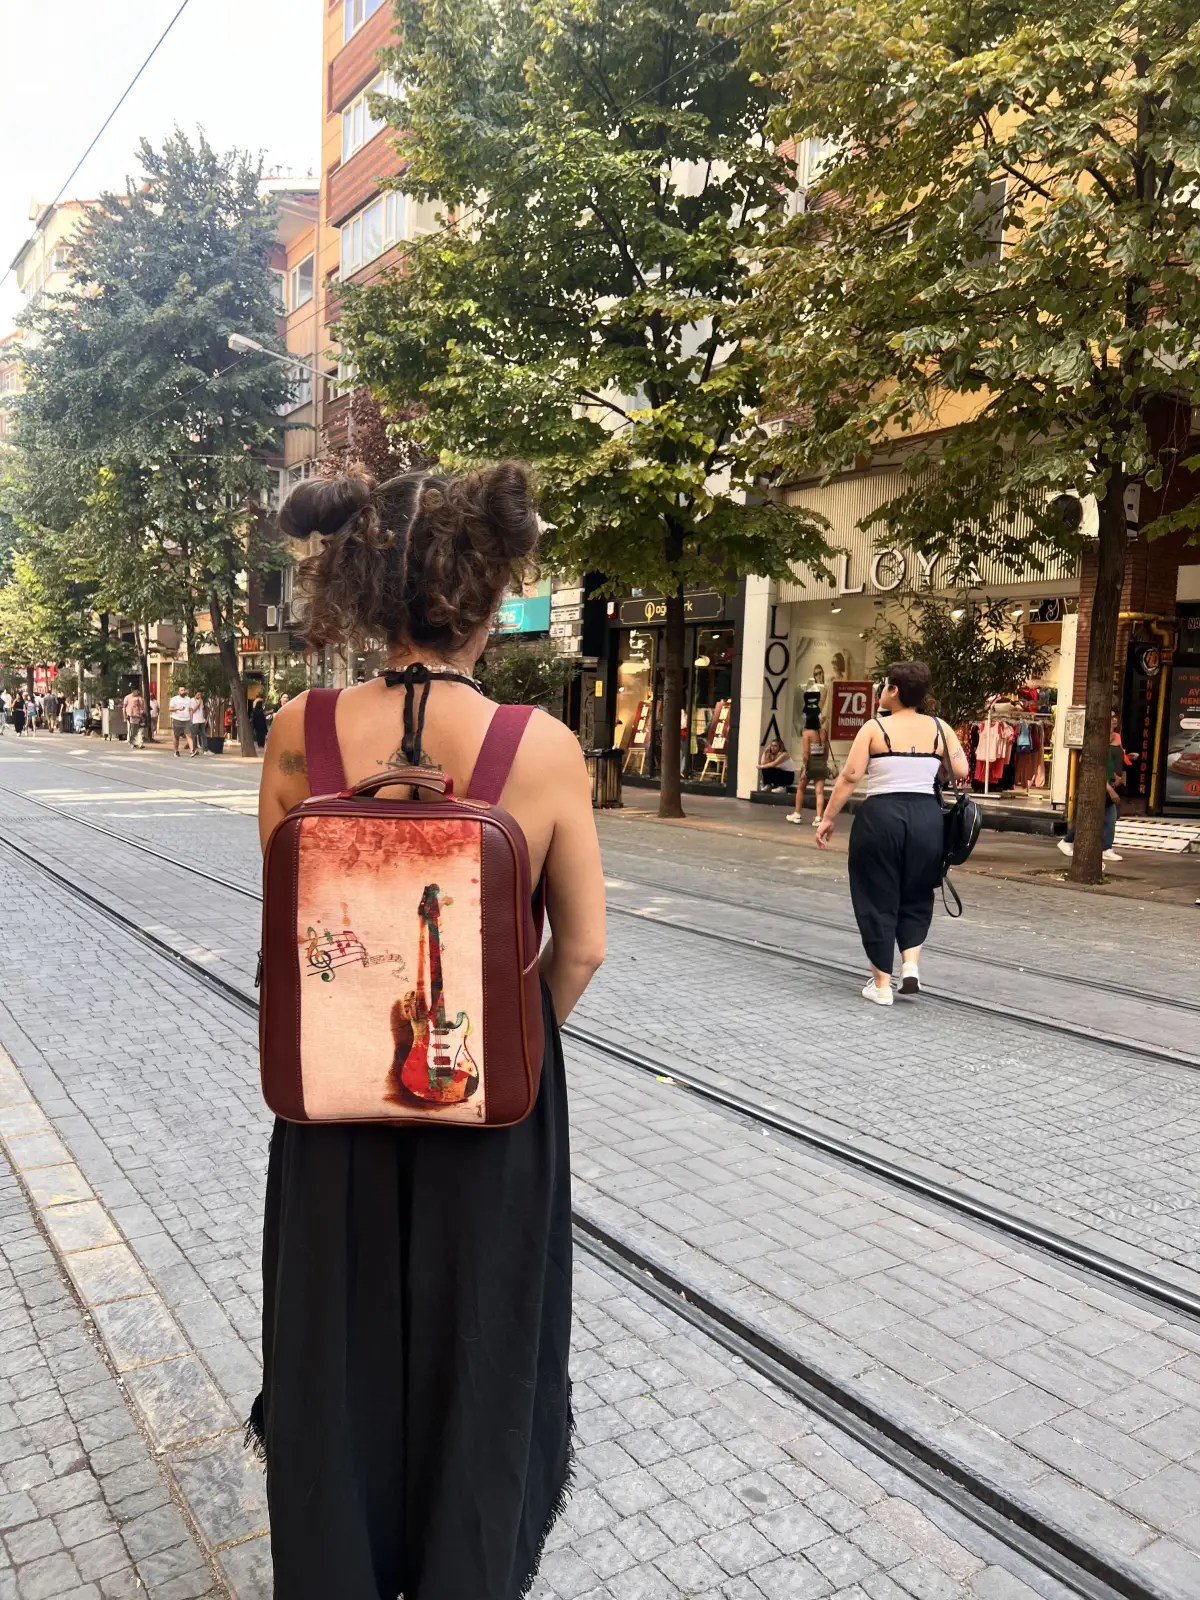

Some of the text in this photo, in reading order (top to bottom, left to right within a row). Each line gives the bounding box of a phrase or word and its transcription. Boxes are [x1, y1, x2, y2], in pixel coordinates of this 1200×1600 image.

[839, 549, 984, 595] LOYA
[760, 605, 788, 752] LOYA
[838, 692, 867, 715] 70
[837, 715, 865, 727] İNDİRİM
